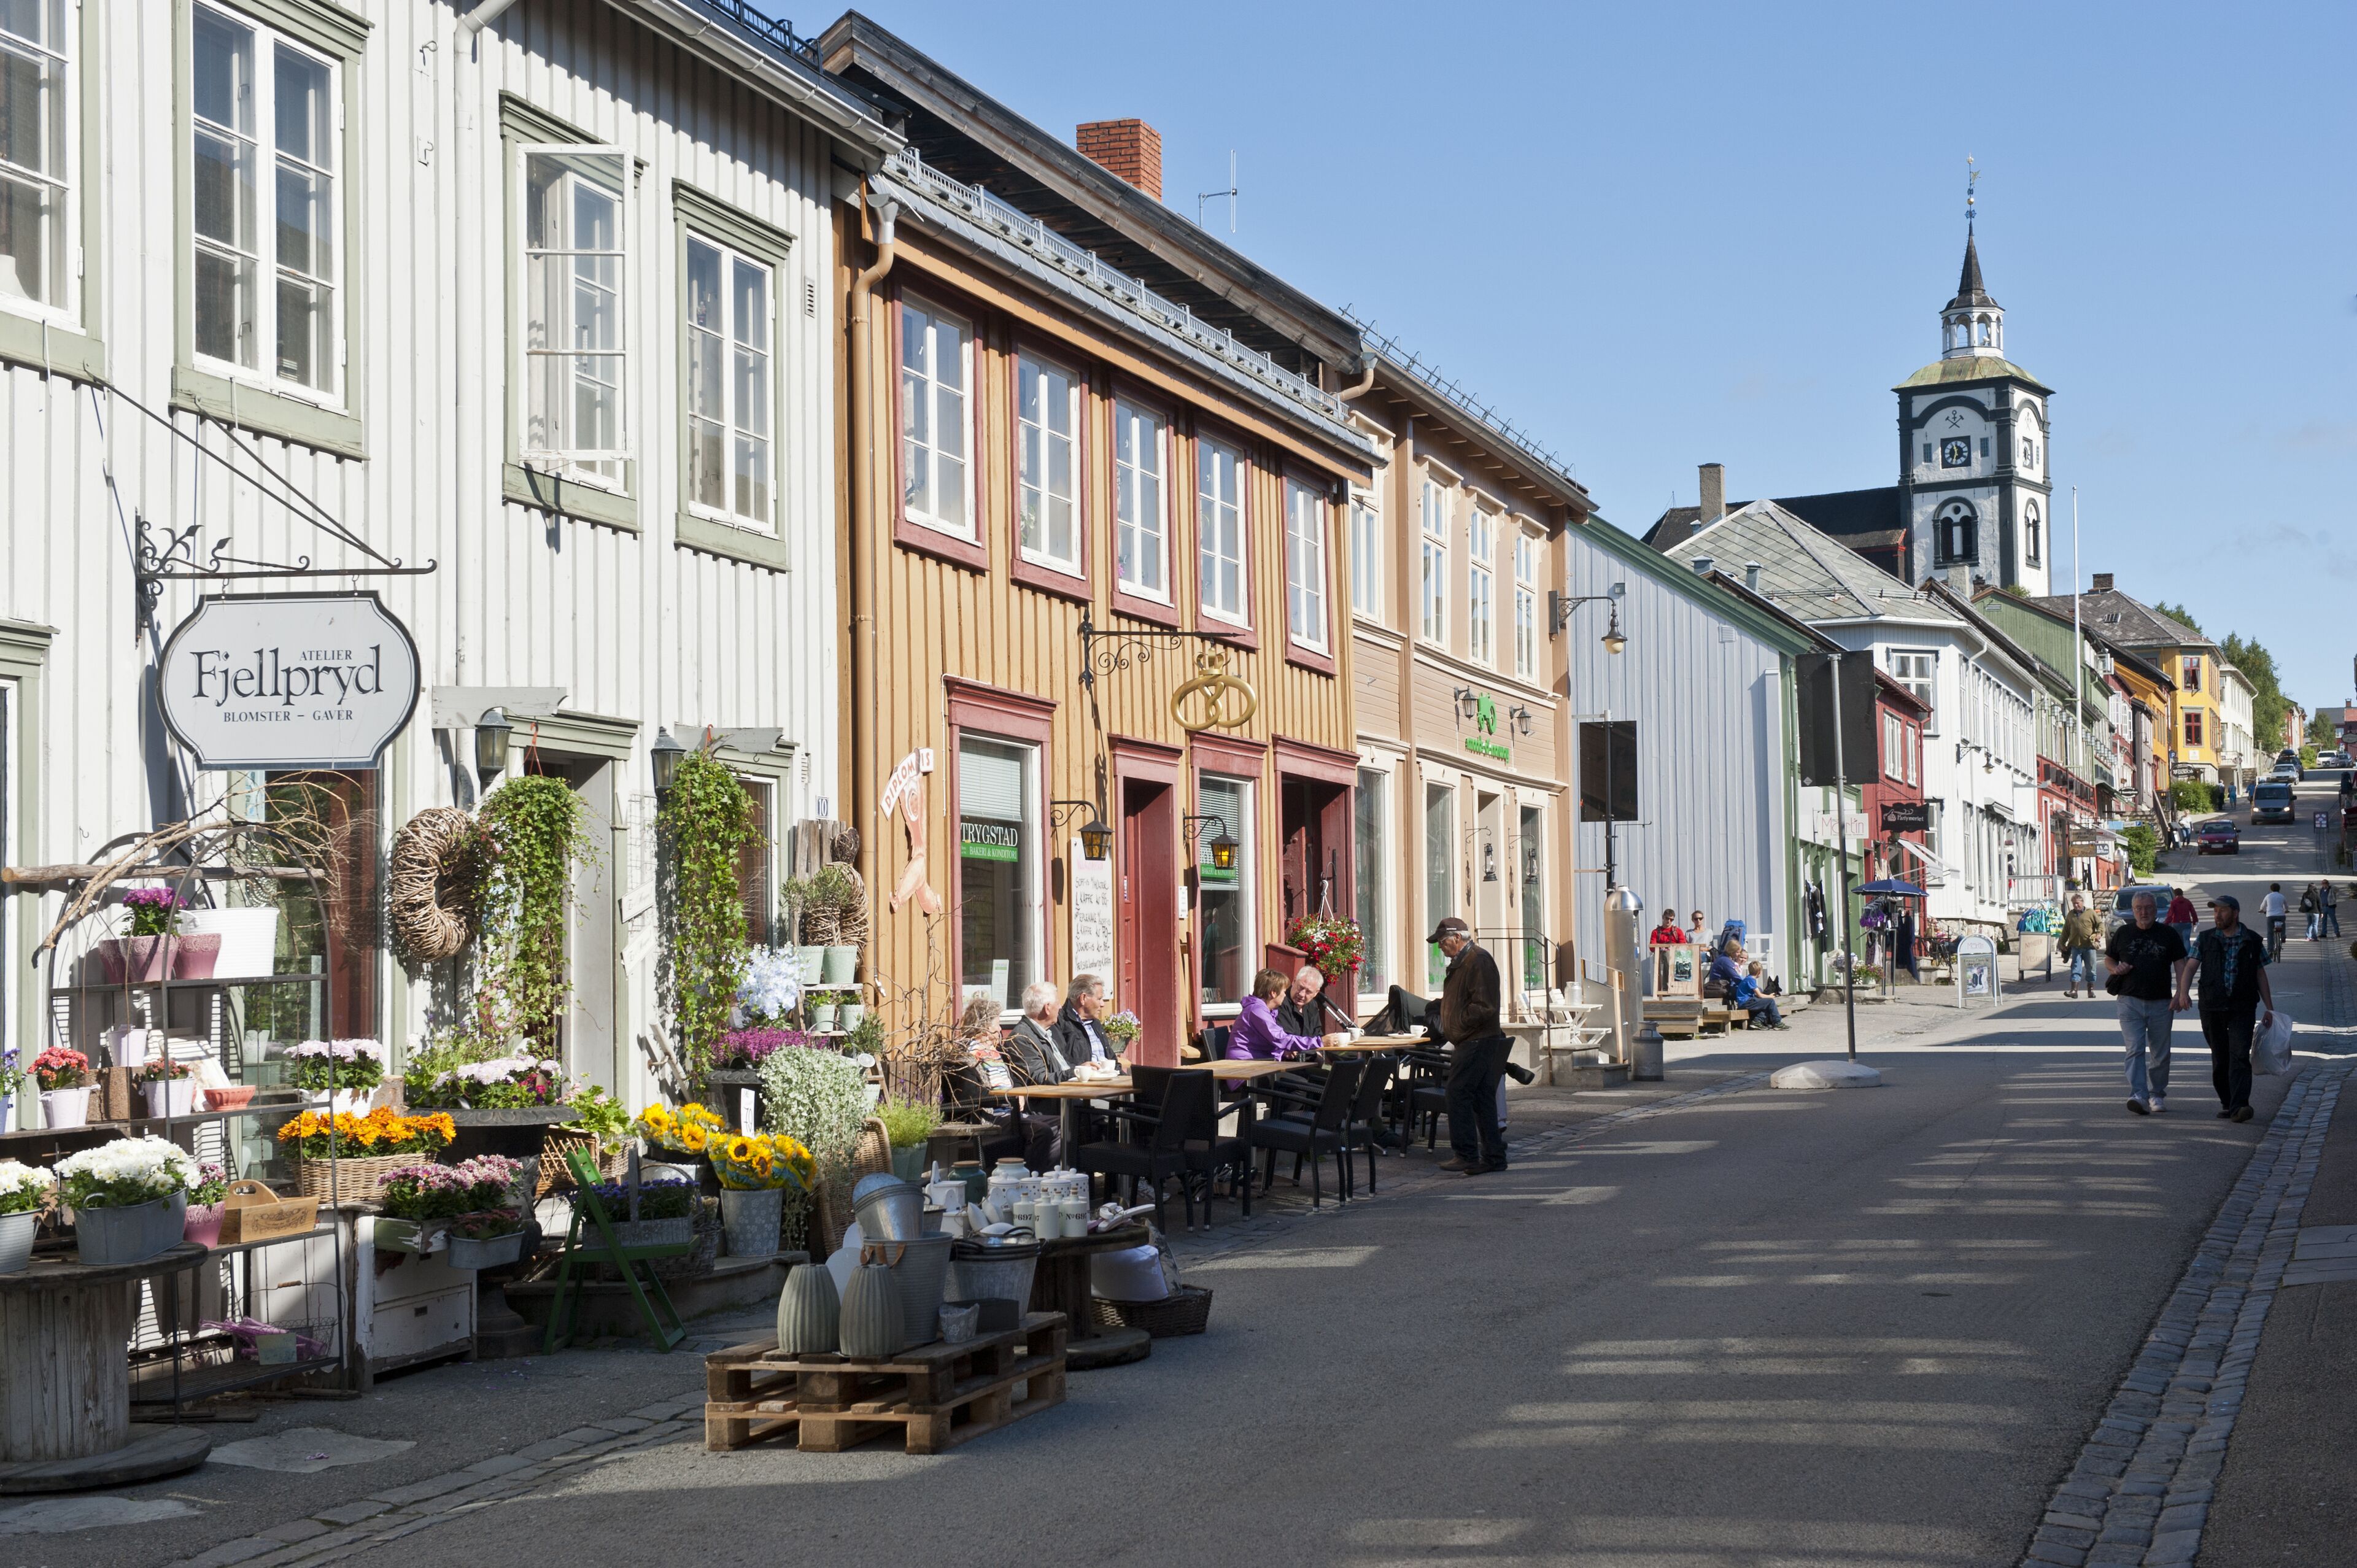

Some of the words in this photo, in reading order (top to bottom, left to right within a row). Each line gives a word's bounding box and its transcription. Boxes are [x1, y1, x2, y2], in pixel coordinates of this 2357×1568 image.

[299, 649, 352, 661] ATELIER
[190, 644, 383, 707] Fjellpryd
[223, 711, 291, 722] BLOMSTER
[312, 709, 353, 721] GAVER
[884, 759, 915, 809] DIPLOM
[921, 752, 931, 767] IS
[818, 798, 827, 816] 10
[961, 823, 1018, 847] TRYGSTAD
[969, 846, 986, 857] BAKERI
[991, 848, 1017, 859] KONDITORI
